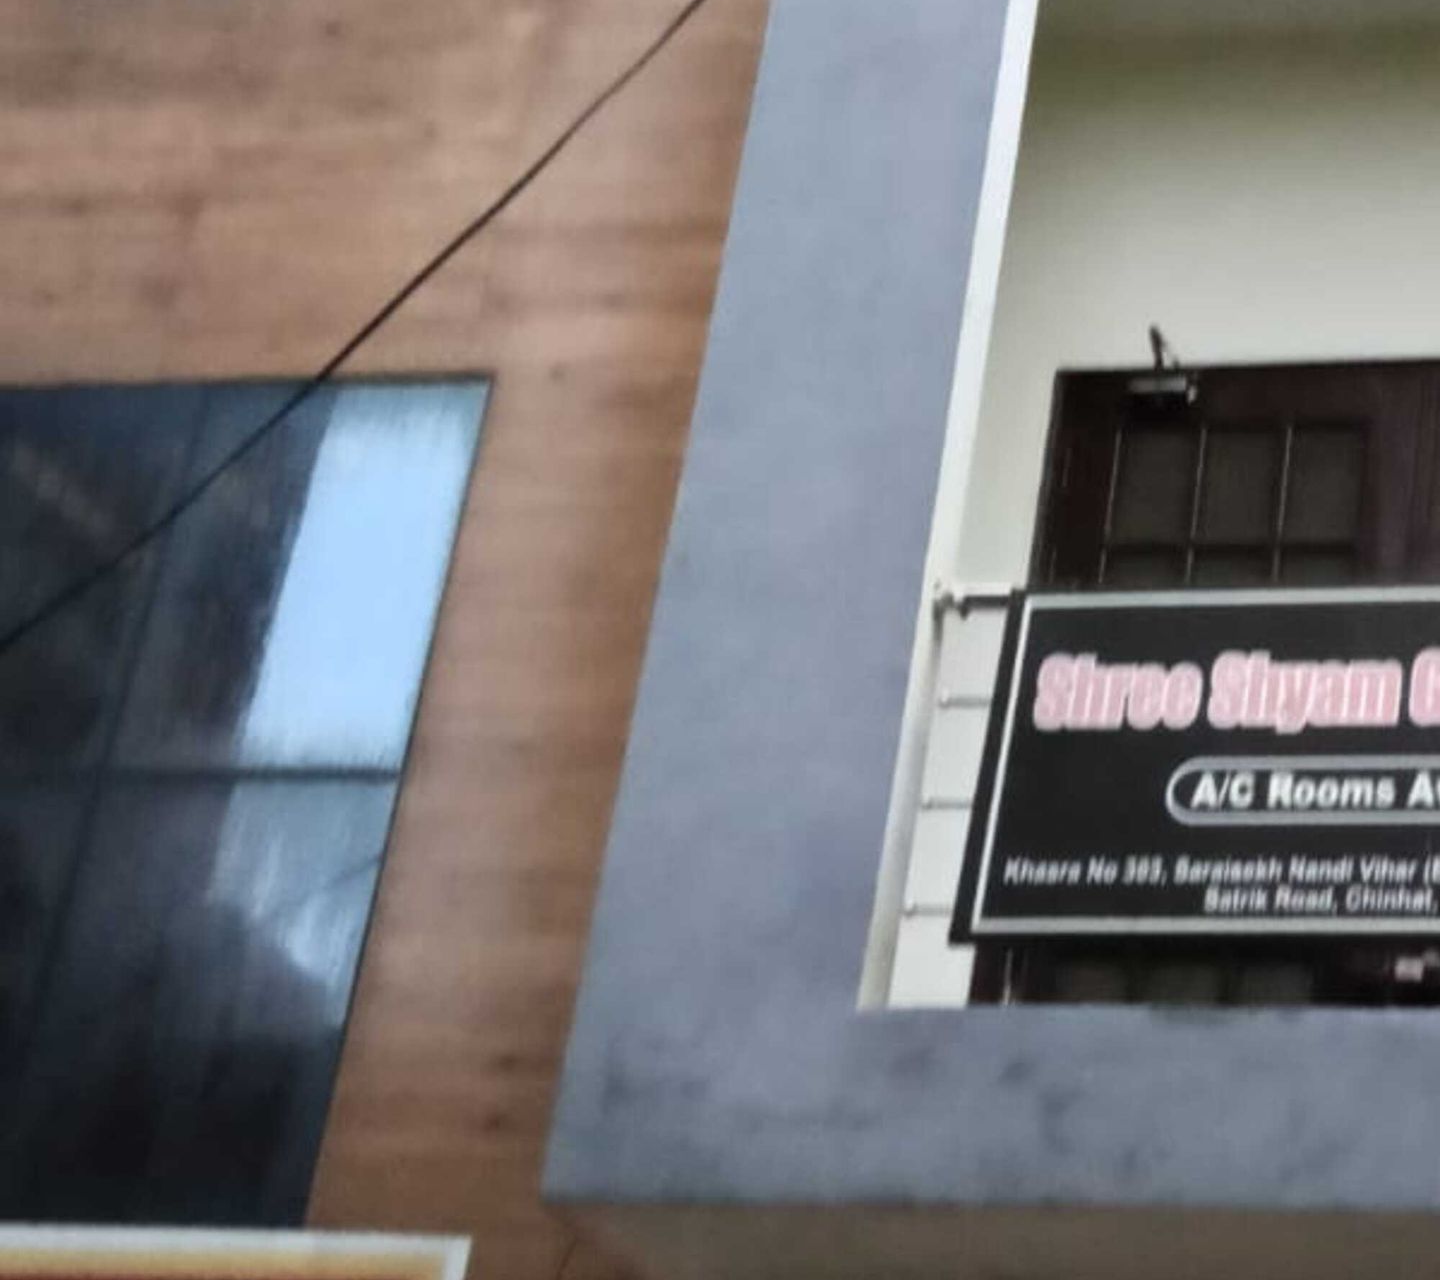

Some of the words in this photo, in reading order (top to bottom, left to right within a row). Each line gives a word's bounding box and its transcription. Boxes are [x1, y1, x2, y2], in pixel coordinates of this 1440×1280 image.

[1033, 653, 1204, 731] Shree
[1206, 650, 1402, 735] Shyam
[1190, 770, 1253, 810] A/C
[1265, 770, 1397, 810] Rooms
[1087, 855, 1119, 886] No
[1359, 854, 1418, 885] Vihar
[1274, 883, 1338, 916] Road,
